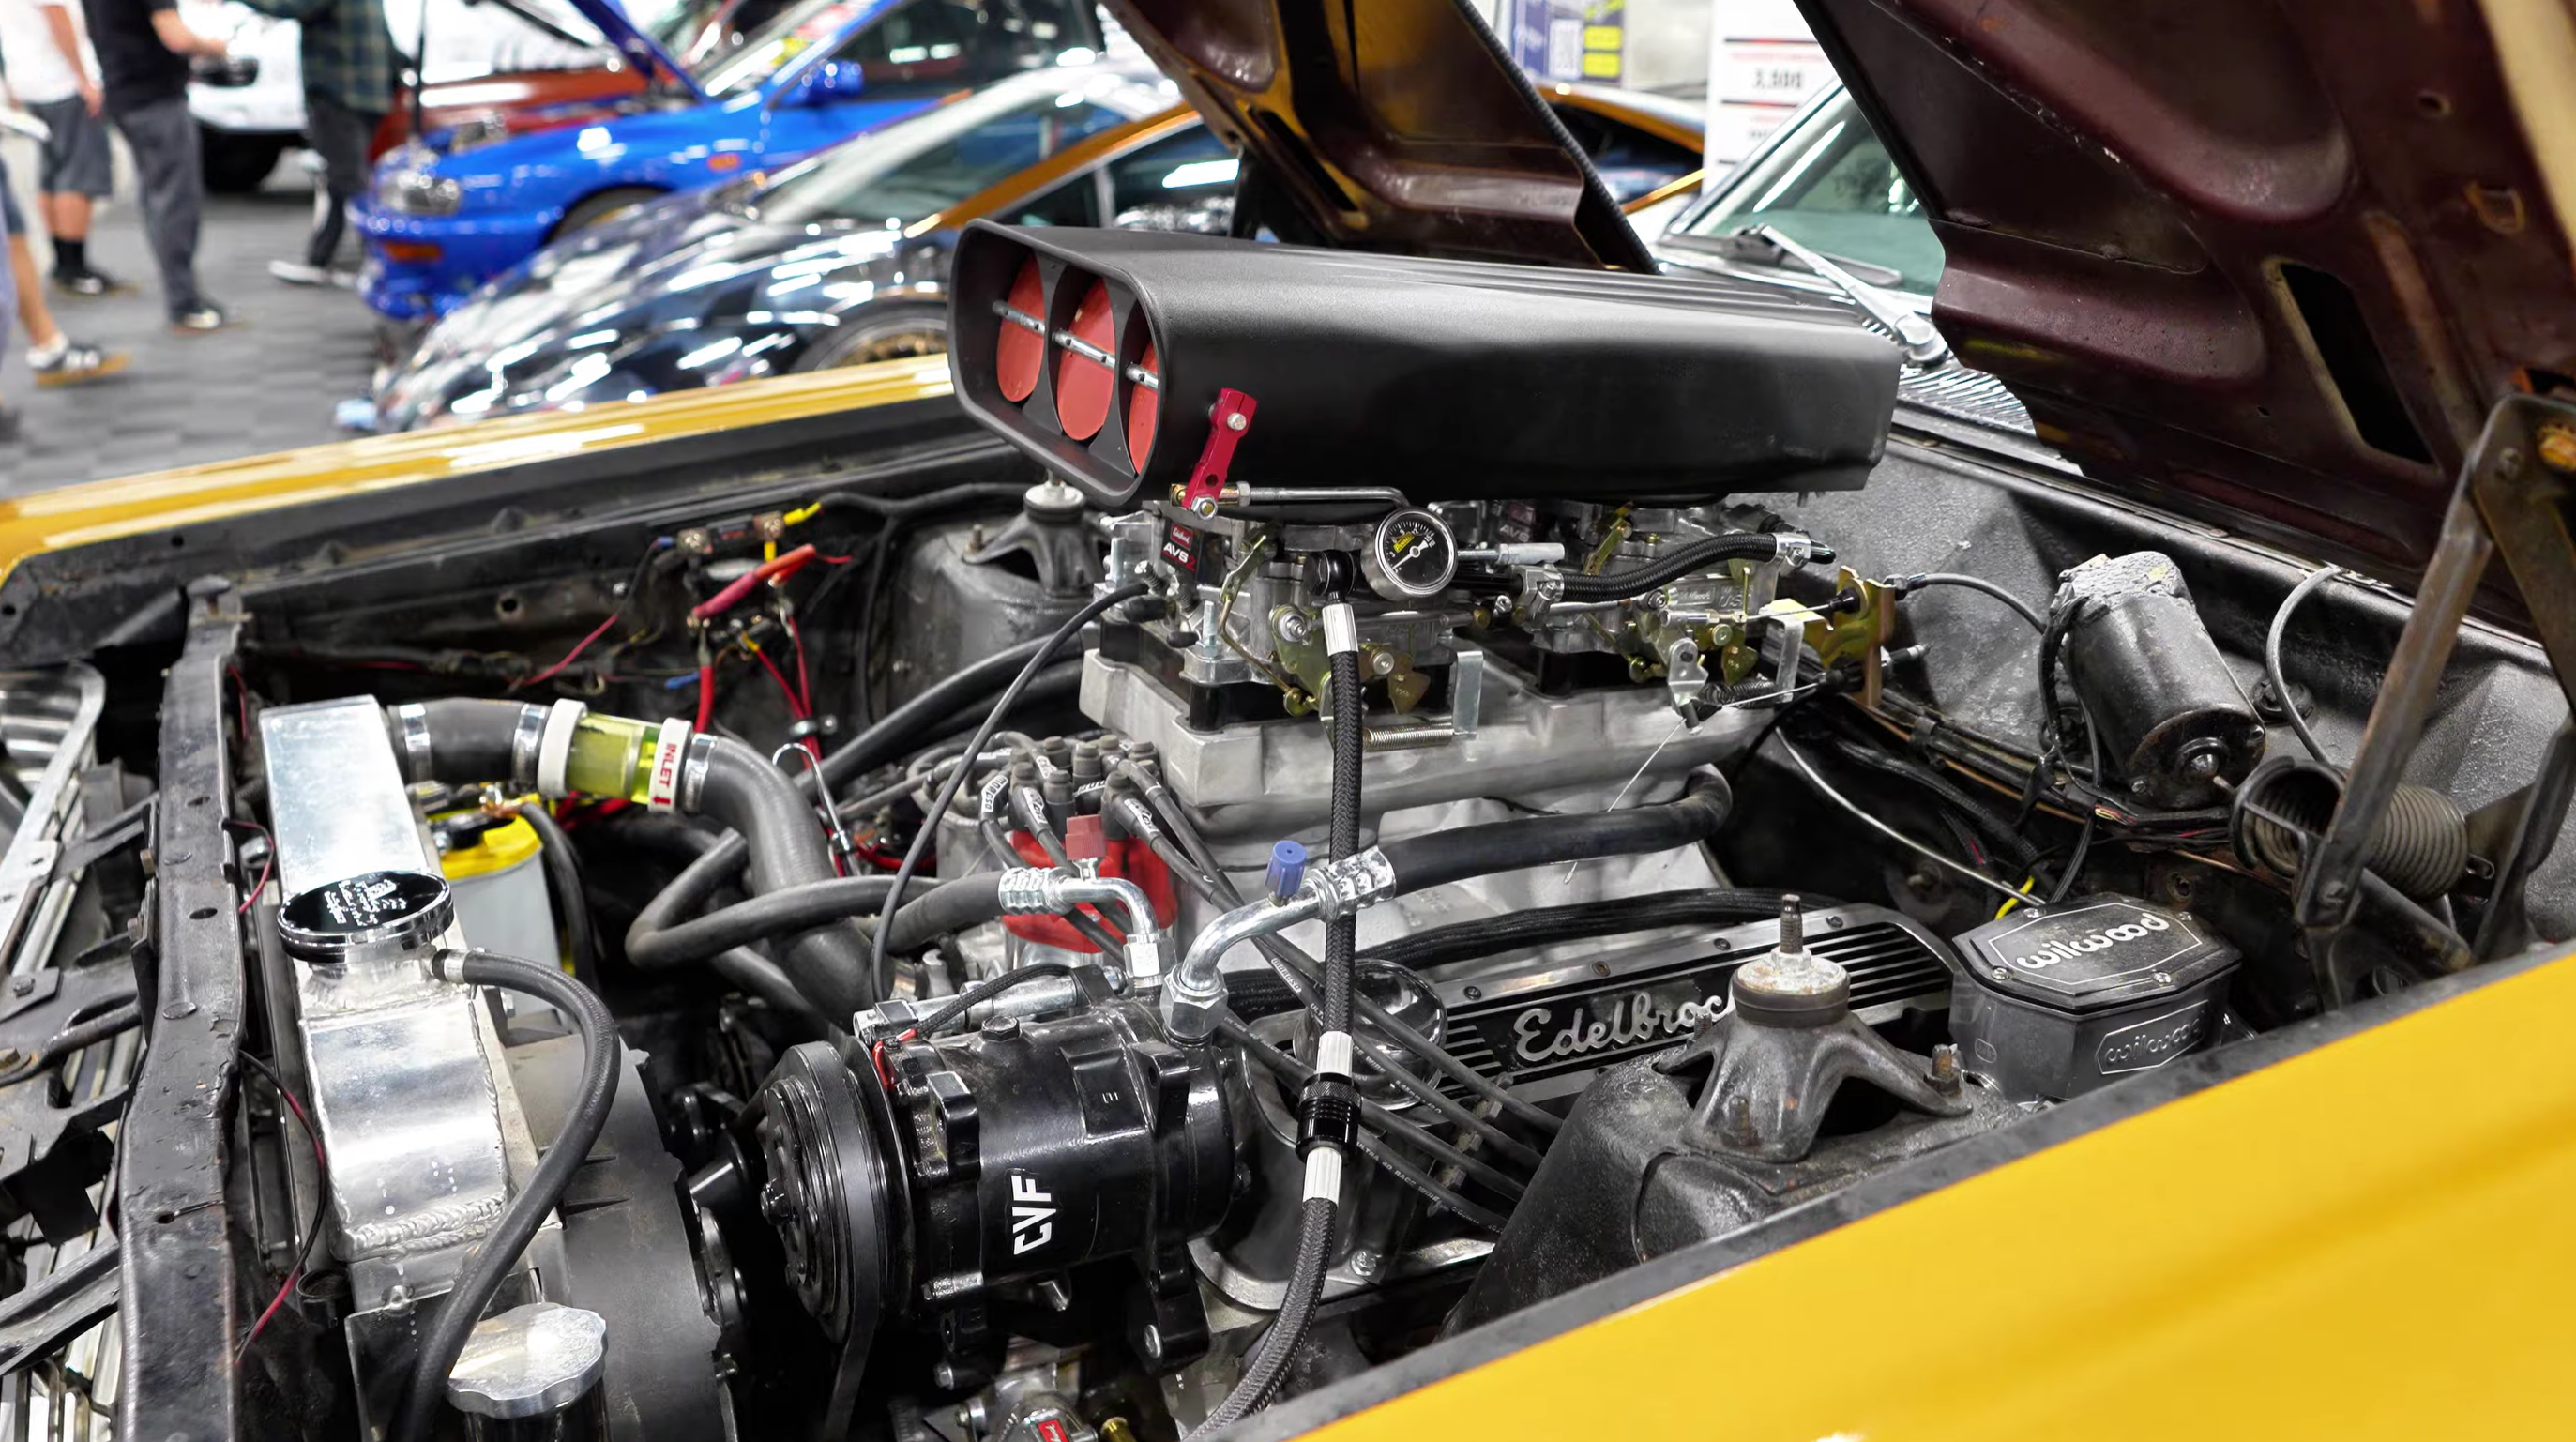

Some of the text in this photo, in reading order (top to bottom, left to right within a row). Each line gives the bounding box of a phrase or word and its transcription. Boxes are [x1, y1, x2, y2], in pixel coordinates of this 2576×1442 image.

[1163, 542, 1197, 572] AVS2
[1500, 524, 1530, 543] AVS
[659, 742, 677, 789] INLET
[2017, 912, 2170, 969] wilwood
[1010, 1175, 1057, 1255] CVF
